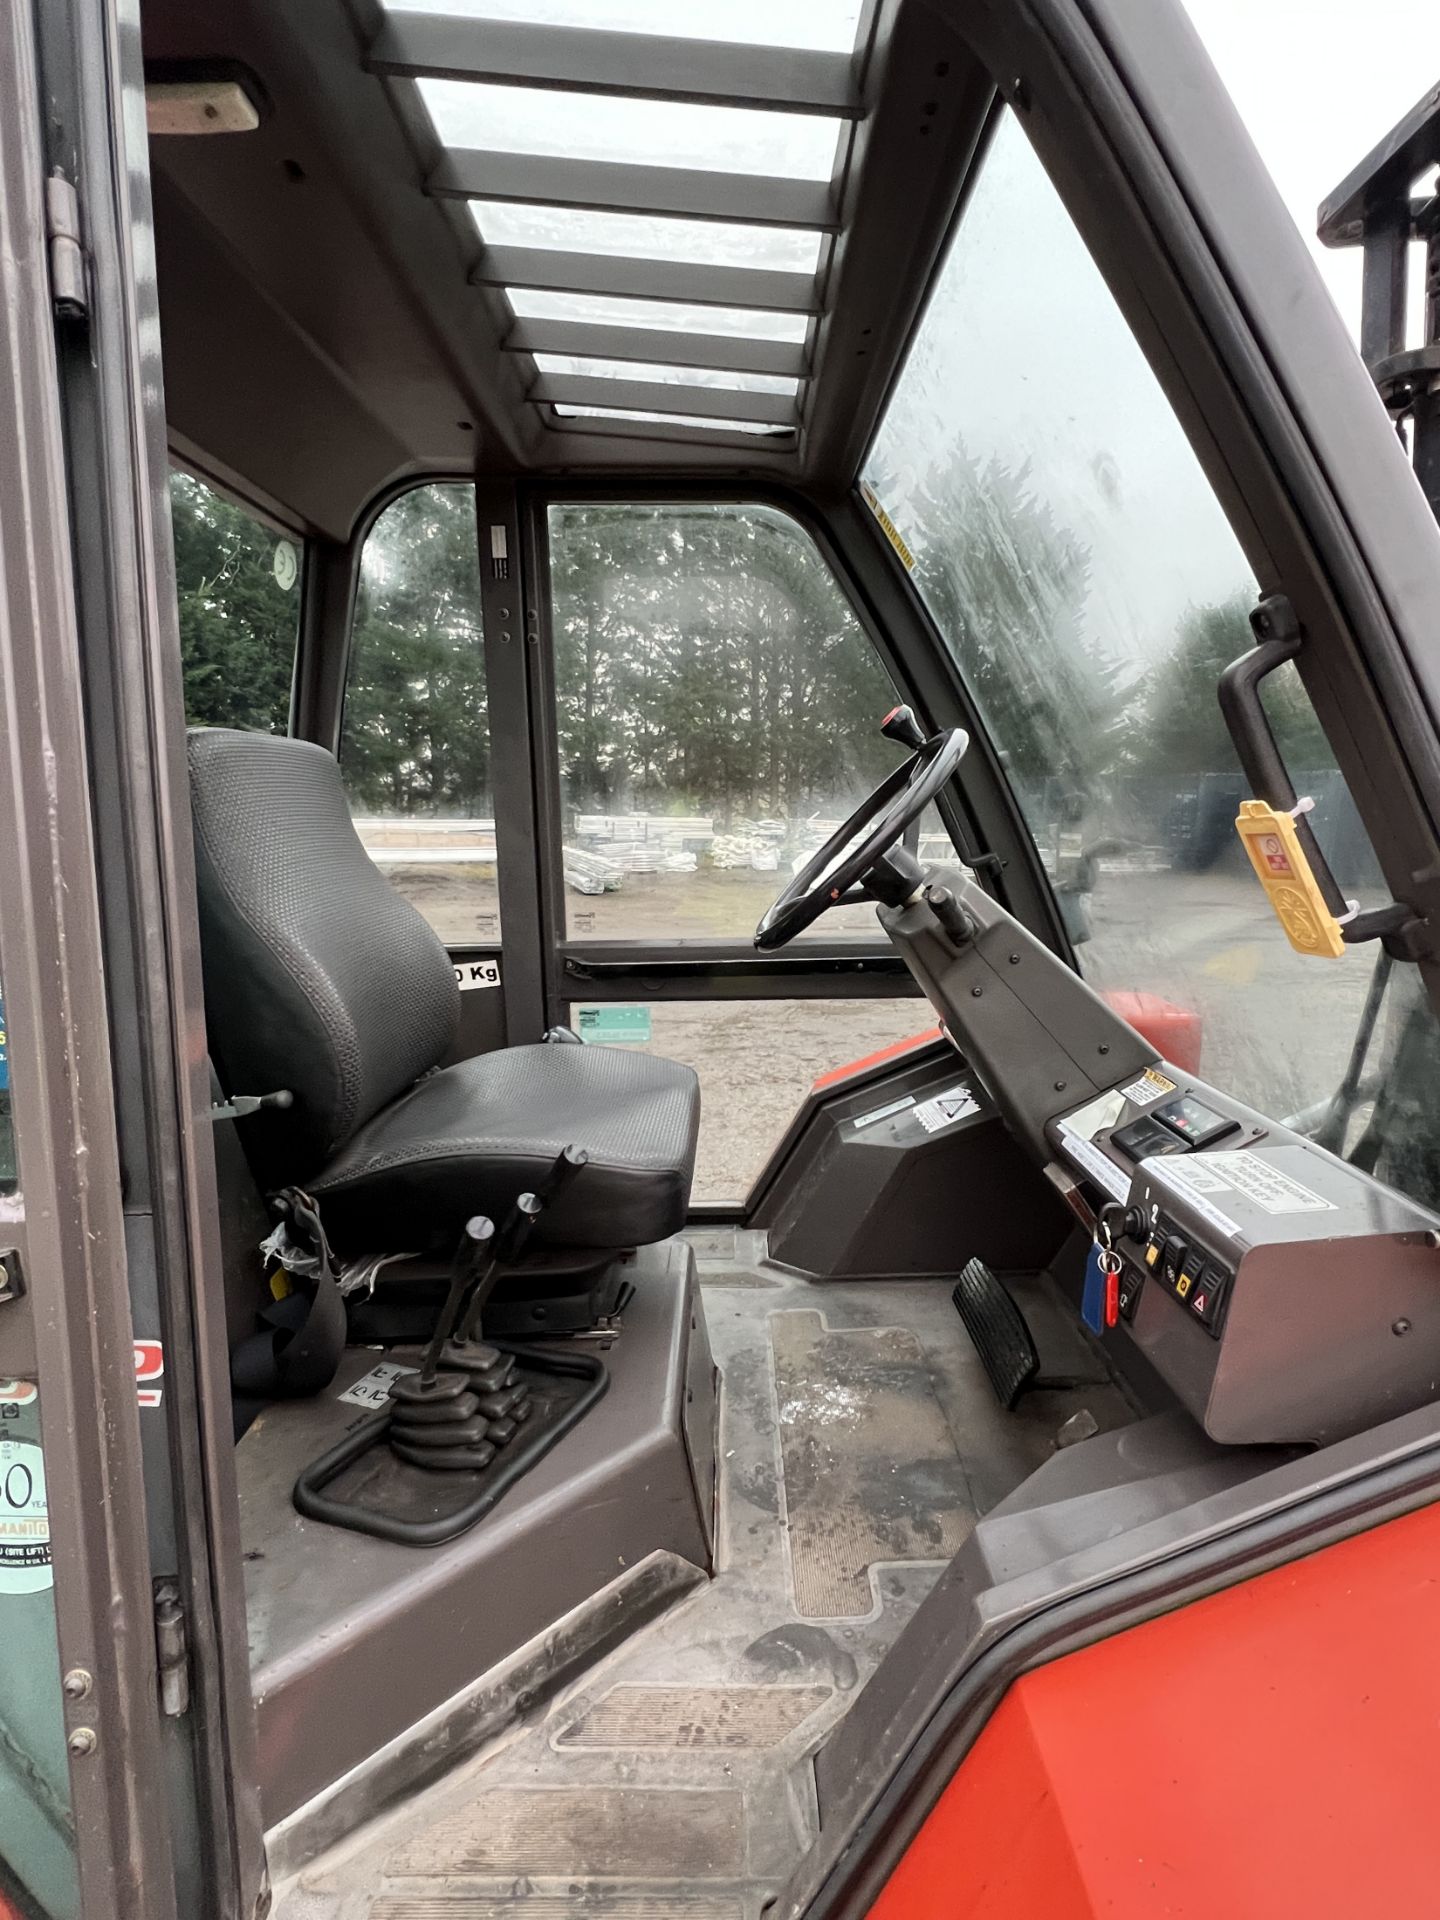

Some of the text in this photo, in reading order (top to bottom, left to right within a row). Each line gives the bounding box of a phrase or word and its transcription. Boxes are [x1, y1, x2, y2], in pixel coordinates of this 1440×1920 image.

[470, 966, 497, 982] Kg
[1212, 1162, 1253, 1188] IGNITION
[1250, 1186, 1275, 1202] KEY
[1249, 1161, 1277, 1181] STOP
[1274, 1177, 1317, 1204] ENGINE
[1151, 1203, 1159, 1225] 2
[5, 1547, 24, 1556] (SITE
